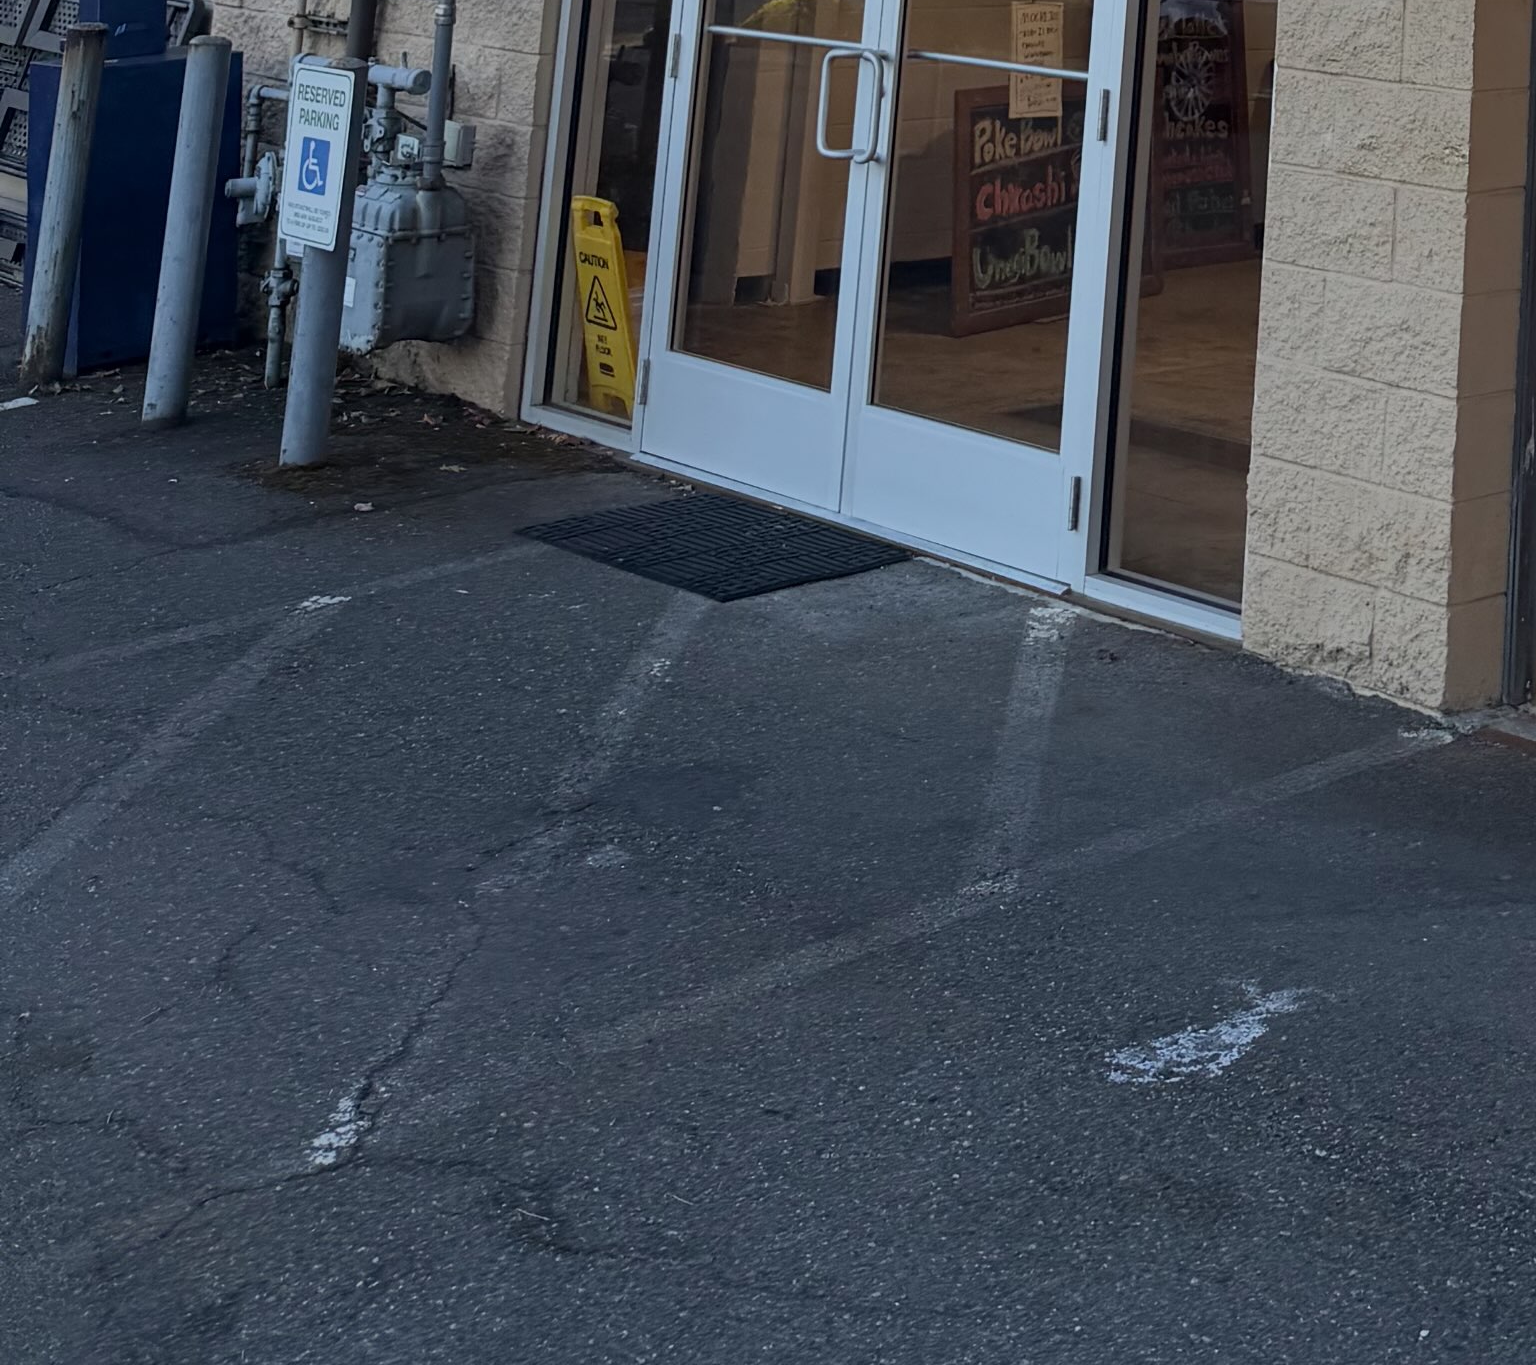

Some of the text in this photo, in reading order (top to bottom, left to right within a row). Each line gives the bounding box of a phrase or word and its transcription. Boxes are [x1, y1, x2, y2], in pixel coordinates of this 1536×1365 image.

[297, 83, 347, 108] RESERVED
[298, 107, 340, 131] PARKING
[974, 119, 1018, 167] Poke
[579, 251, 610, 270] CAUTION
